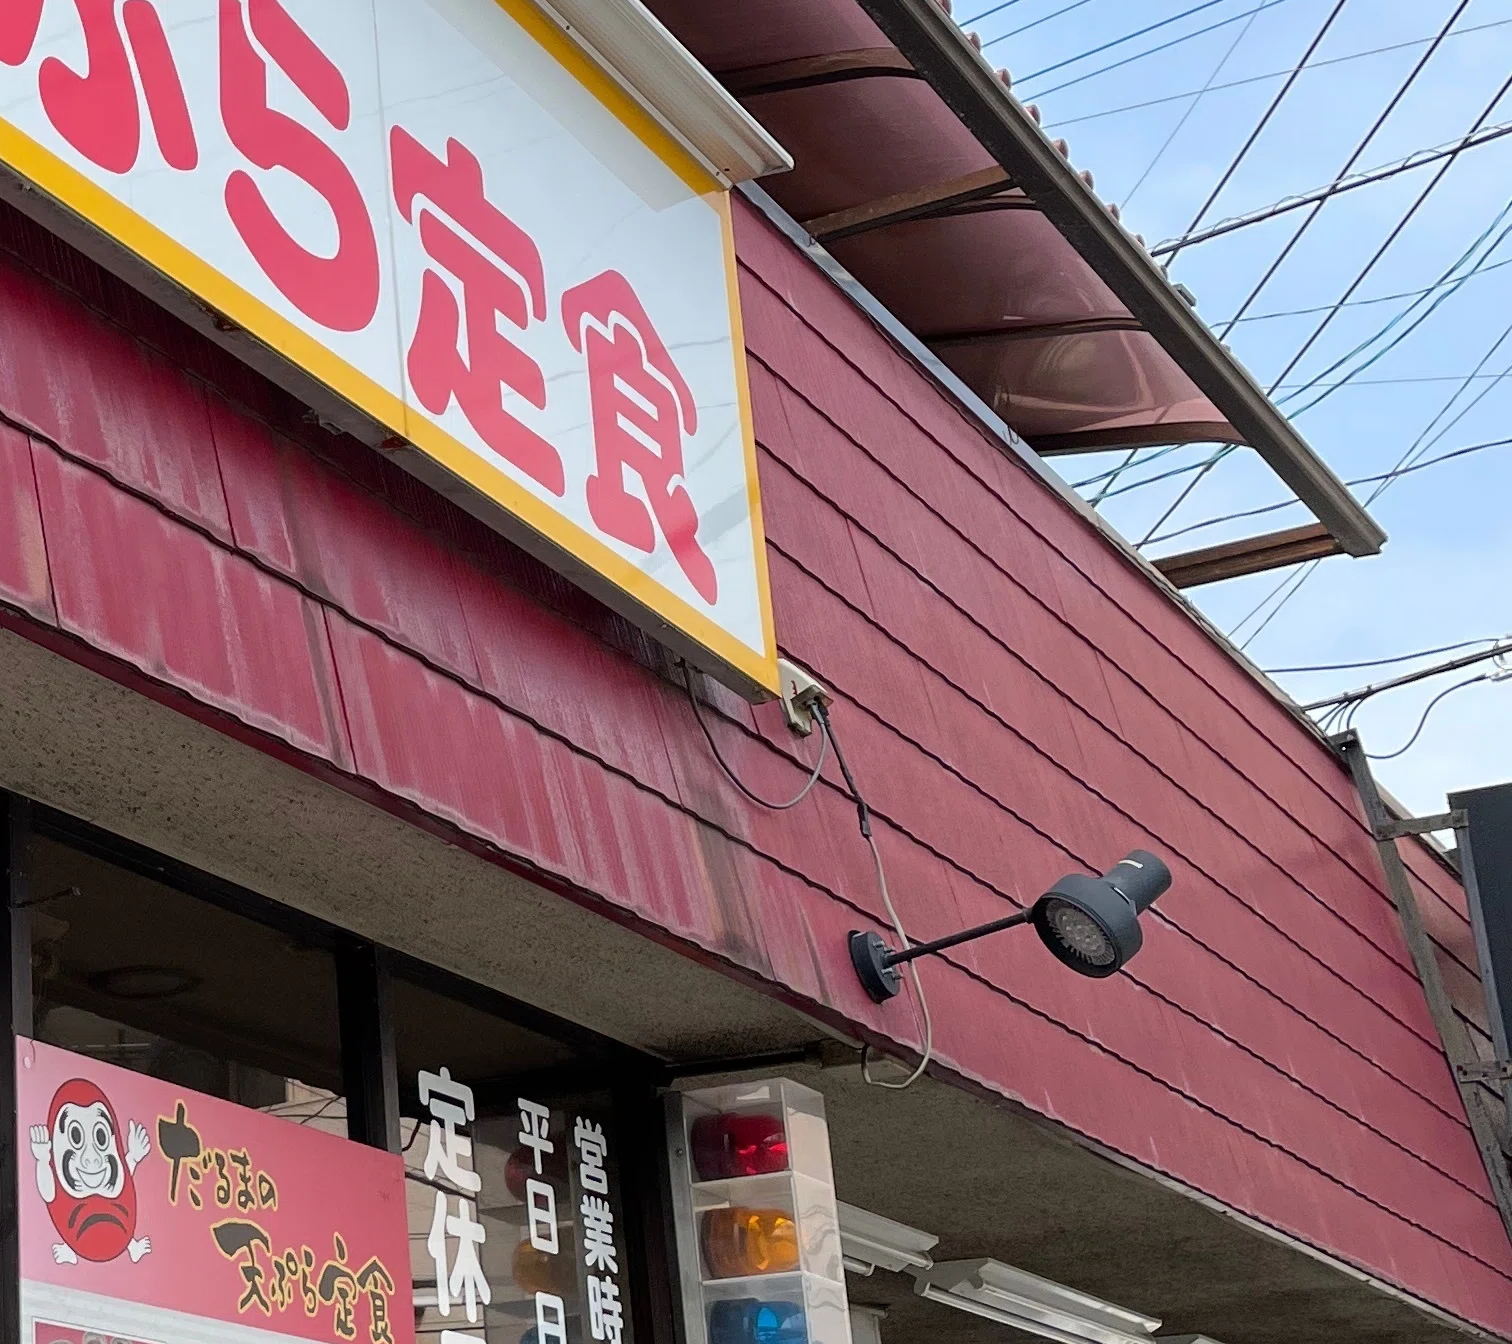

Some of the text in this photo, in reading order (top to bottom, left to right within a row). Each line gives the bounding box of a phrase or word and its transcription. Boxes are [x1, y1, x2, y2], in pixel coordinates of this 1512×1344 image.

[157, 1099, 278, 1211] だるまの
[517, 1097, 559, 1255] 平日
